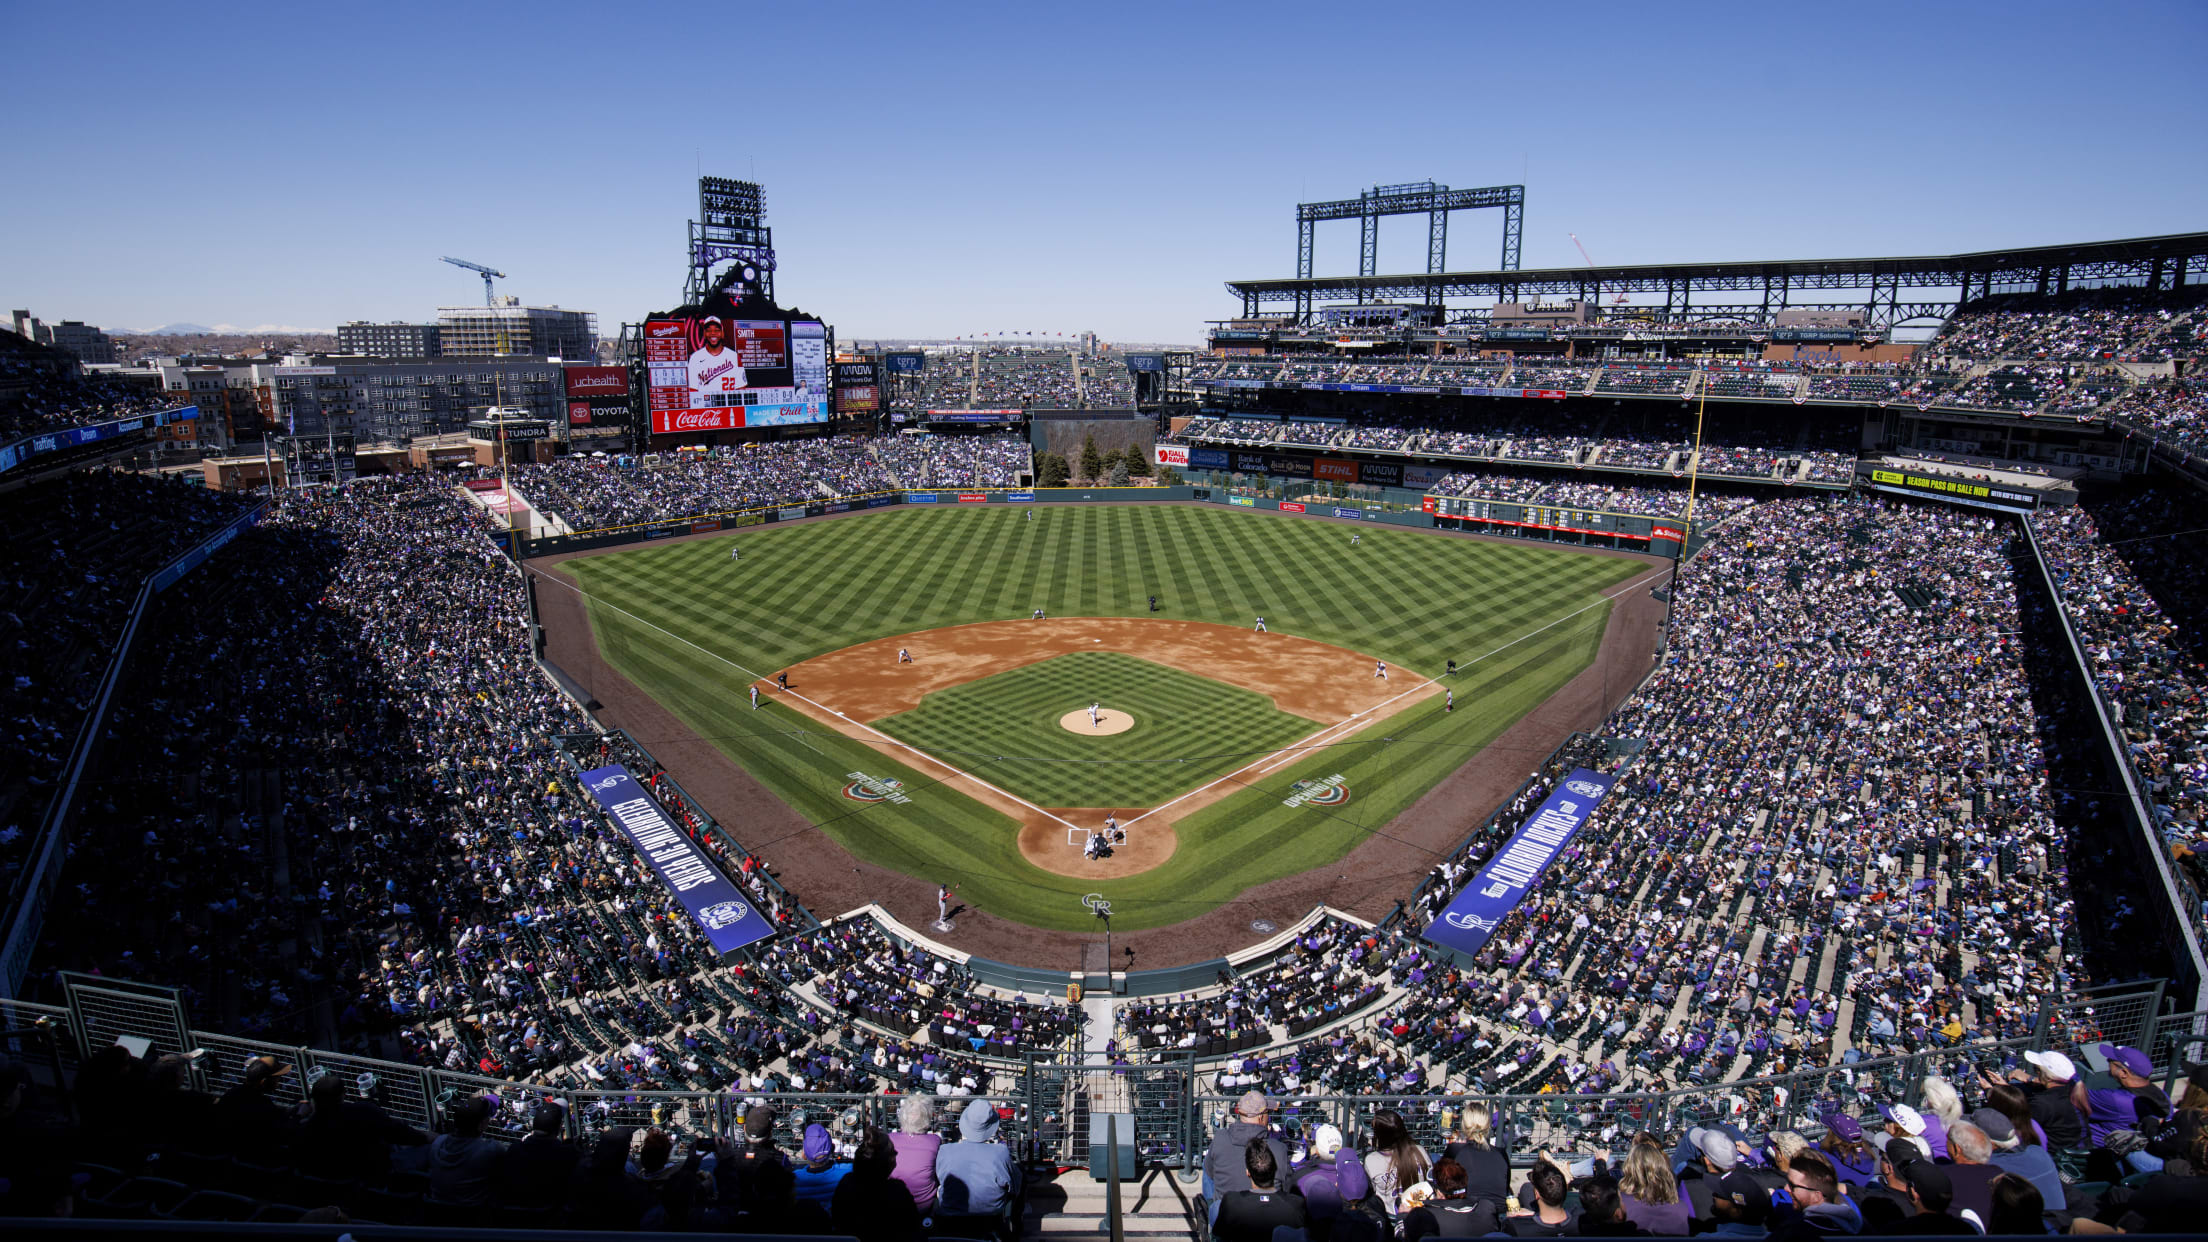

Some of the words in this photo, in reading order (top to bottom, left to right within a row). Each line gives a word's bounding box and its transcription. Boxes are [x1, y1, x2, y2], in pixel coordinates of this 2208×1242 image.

[695, 244, 777, 271] ROCKIES
[737, 329, 755, 338] SMITH
[1793, 345, 1841, 361] Coors
[897, 356, 917, 368] tgrp
[1133, 356, 1153, 370] tgrp
[698, 359, 734, 386] Nationals
[574, 374, 619, 387] uchealth
[722, 377, 735, 391] 22
[1301, 382, 1323, 391] Drafting
[1351, 384, 1370, 392] Dream
[845, 389, 871, 399] KING
[591, 406, 629, 416] TOYOTA
[780, 405, 803, 417] Chill
[676, 409, 723, 428] Coca-Cola
[80, 429, 97, 441] Dream
[508, 428, 546, 437] TUNDRA
[1238, 454, 1253, 463] Bank
[1254, 455, 1262, 463] of
[1238, 461, 1268, 472] Colorado
[1319, 464, 1353, 476] STIHL
[1405, 471, 1429, 484] Coors
[1907, 477, 1930, 488] SEASON
[1931, 480, 1947, 491] PASS
[1947, 482, 1957, 492] ON
[1957, 484, 1973, 494] SALE
[1973, 486, 1990, 497] NOW
[1230, 496, 1253, 506] bet365
[611, 798, 681, 851] CELEBRATING
[1523, 808, 1580, 846] ROCKIES
[650, 843, 691, 864] 30
[1486, 838, 1554, 889] COLORADO
[660, 855, 717, 892] YEARS
